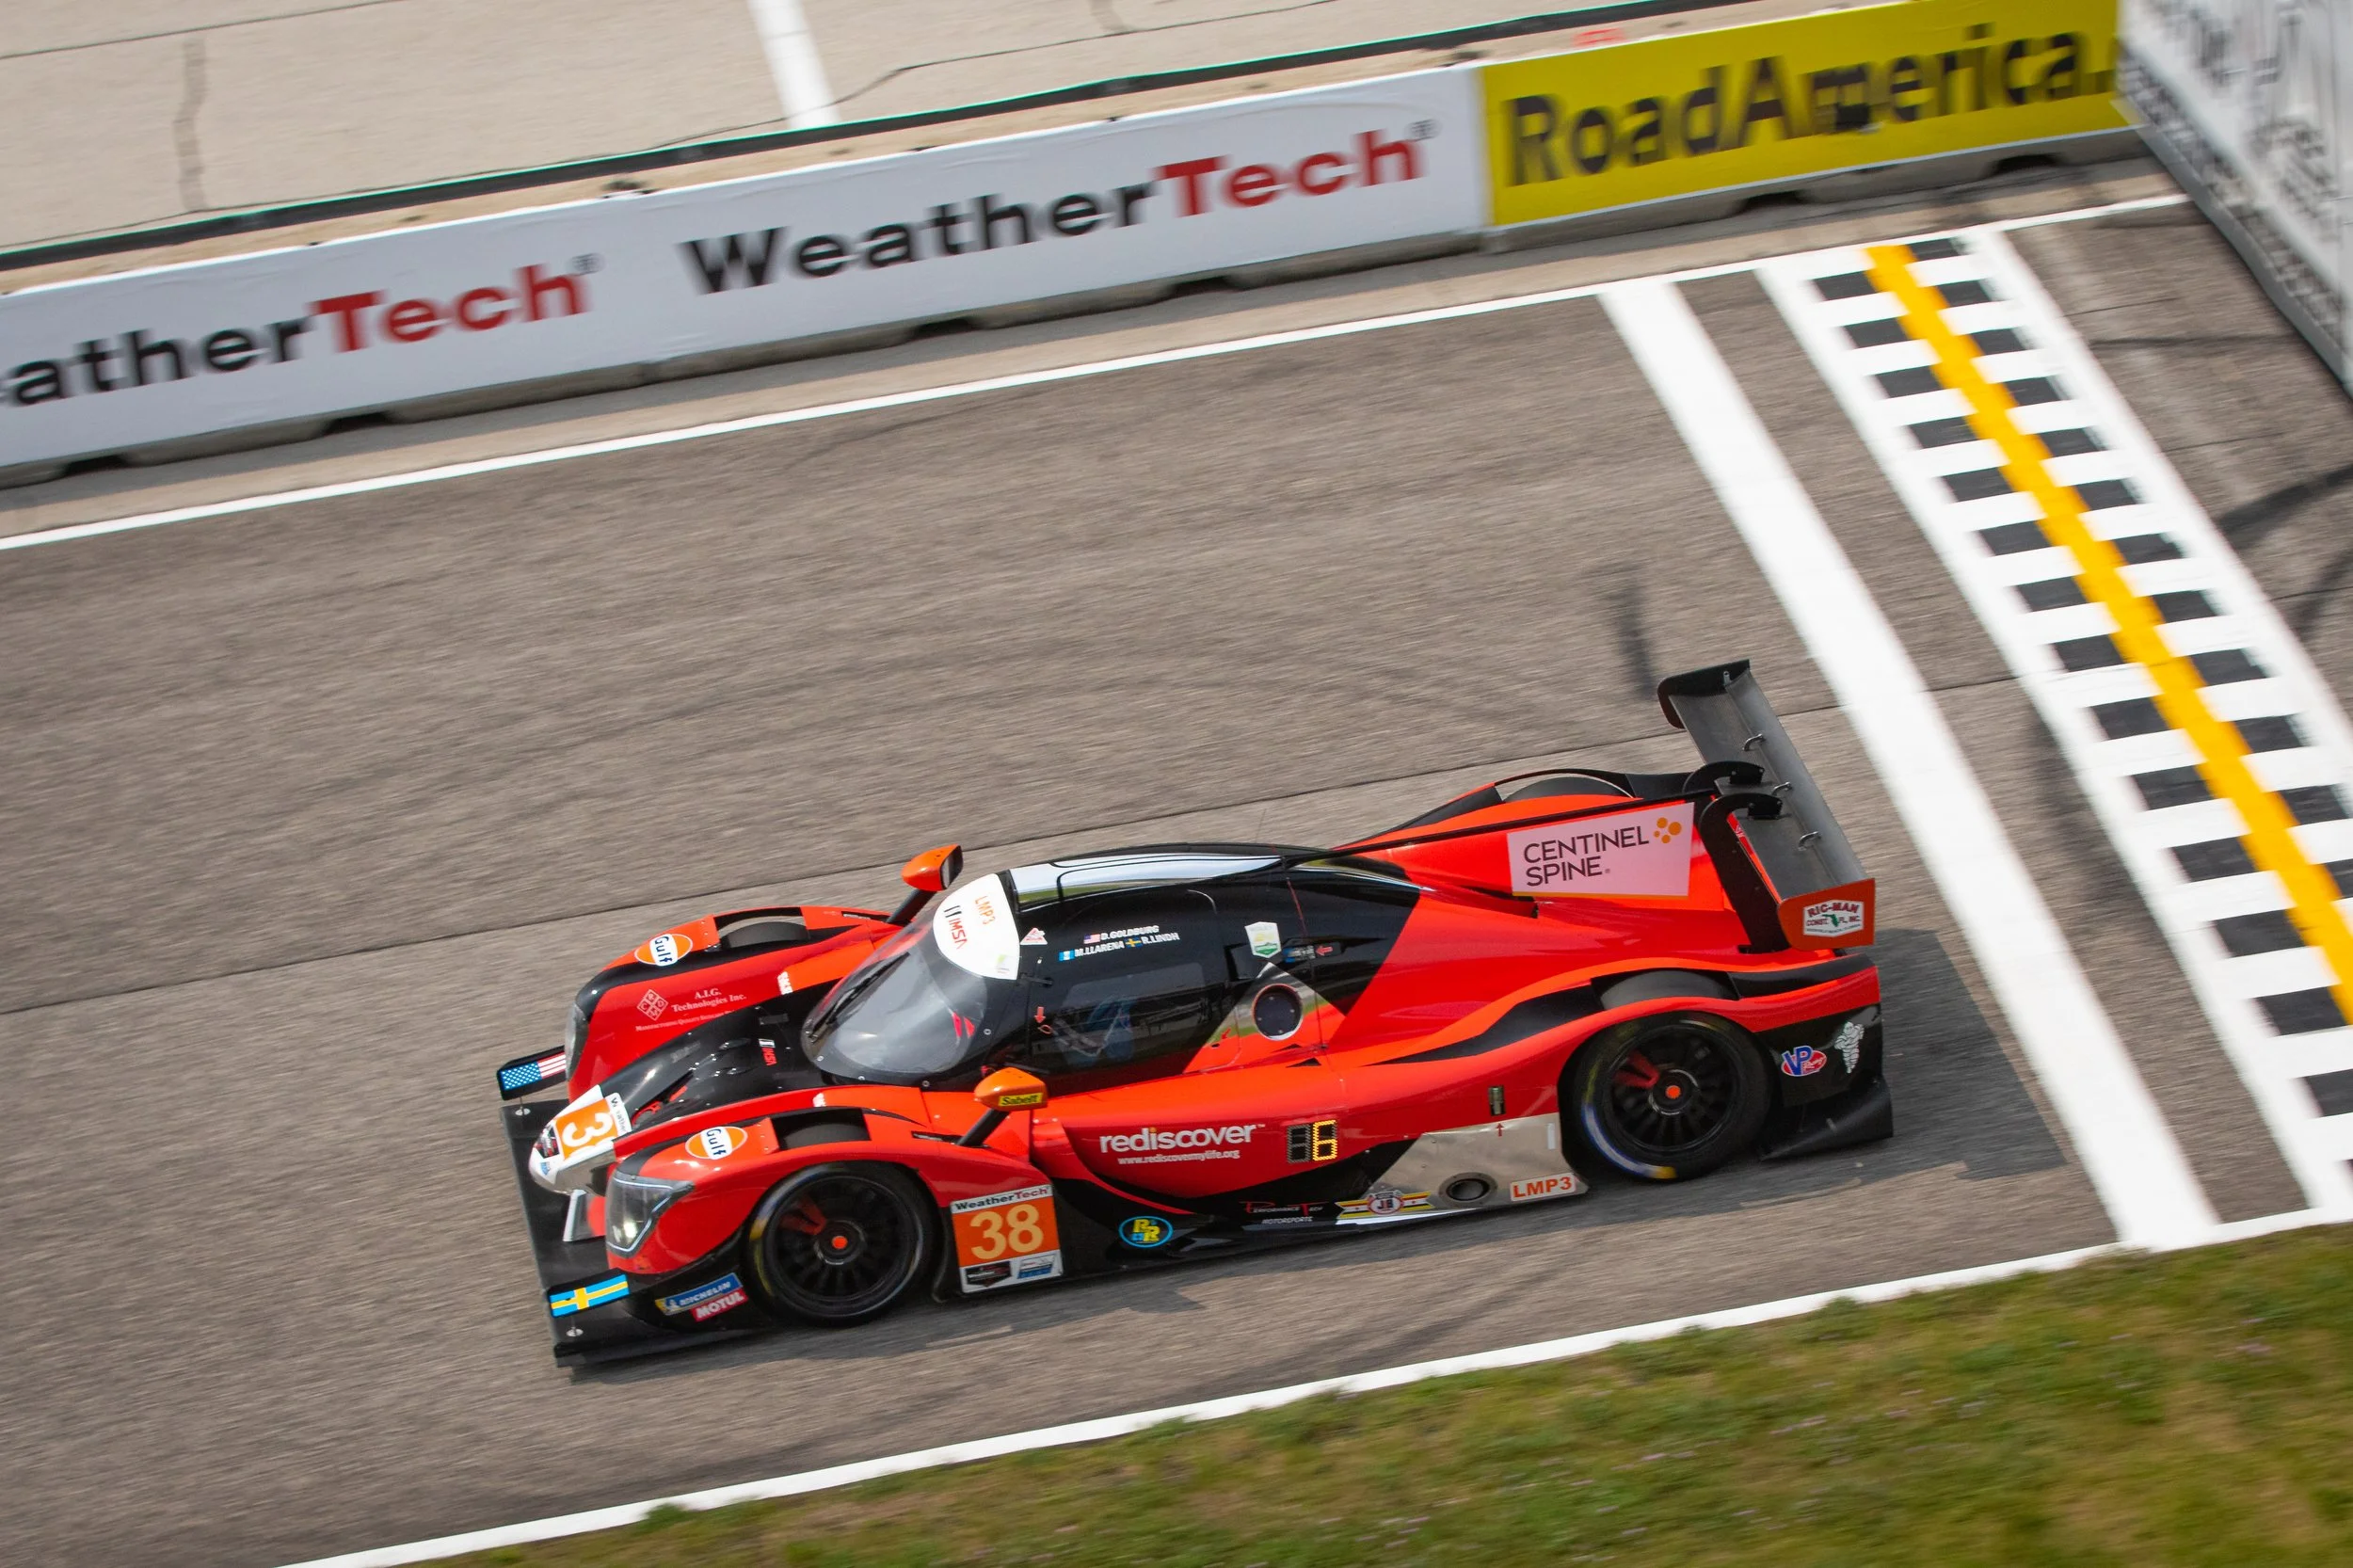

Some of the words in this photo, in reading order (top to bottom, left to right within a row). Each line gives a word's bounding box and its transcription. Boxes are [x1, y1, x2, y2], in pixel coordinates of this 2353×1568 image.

[680, 129, 1429, 296] WeatherTech
[0, 263, 589, 407] atherTech
[1524, 825, 1649, 864] CENTINEL
[1527, 856, 1603, 887] SPINE
[974, 895, 996, 925] LMP3
[1807, 902, 1860, 918] RIC-MAN
[655, 936, 673, 963] Gulf
[671, 996, 728, 1013] Technologies
[729, 993, 747, 1002] Inc.
[694, 987, 722, 1000] A.I.G.
[1782, 1045, 1814, 1077] VP
[706, 1128, 727, 1156] Gulf
[1099, 1124, 1257, 1153] rediscover
[954, 1188, 1048, 1210] WeatherTech
[1513, 1176, 1573, 1197] LMP3
[969, 1204, 1044, 1259] 38
[680, 1281, 731, 1305] MICHELIN
[696, 1291, 745, 1319] MOTUL
